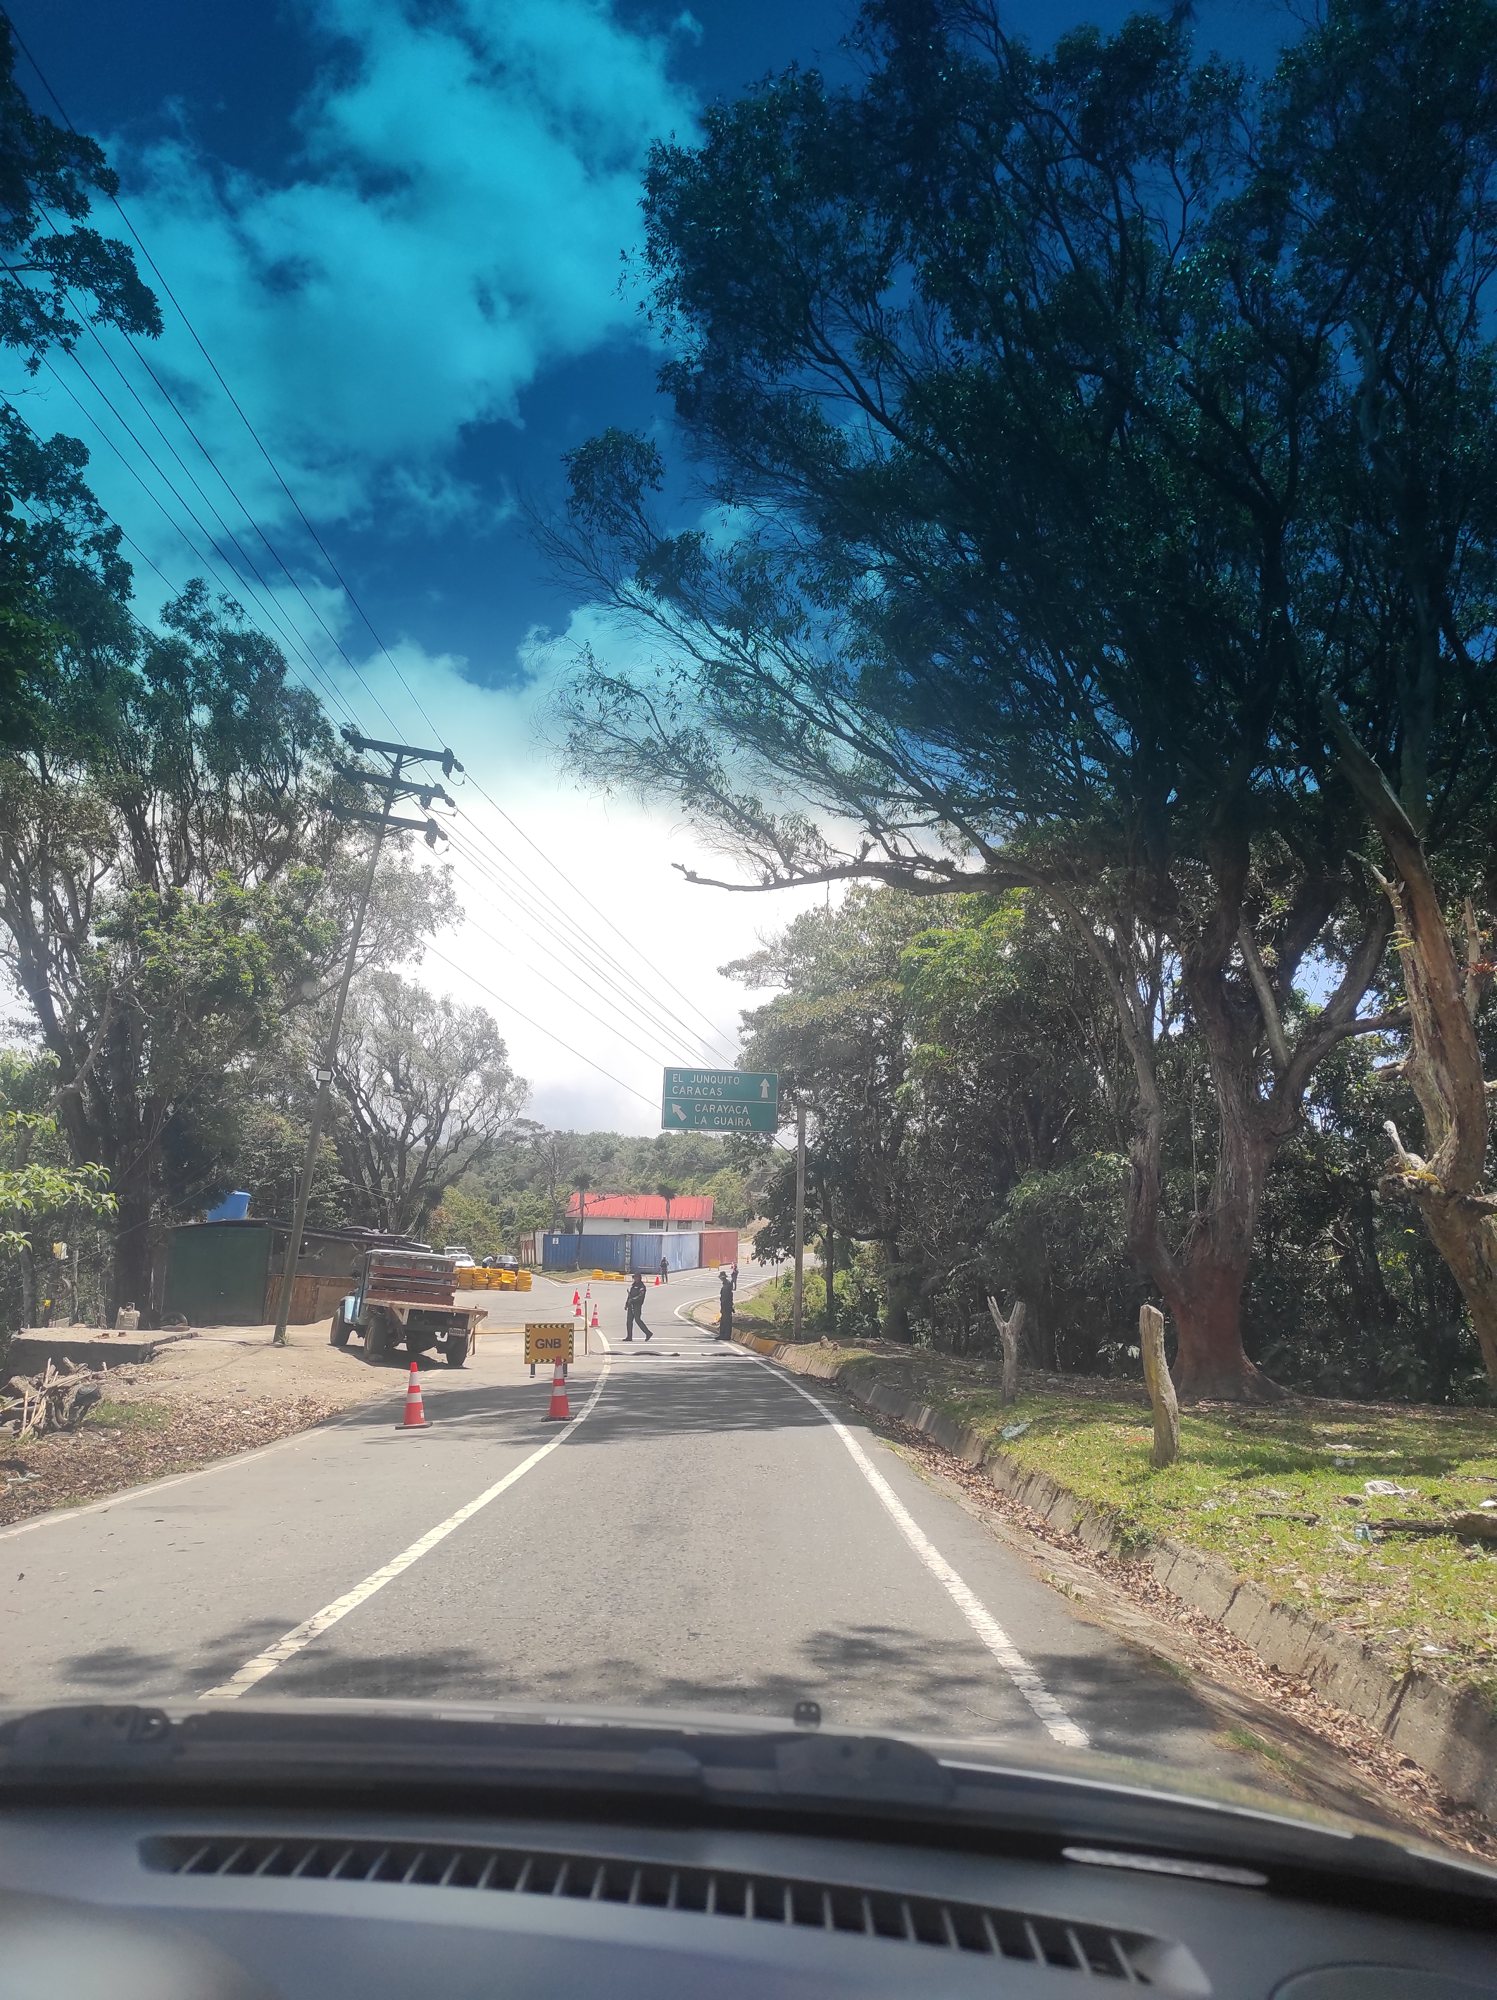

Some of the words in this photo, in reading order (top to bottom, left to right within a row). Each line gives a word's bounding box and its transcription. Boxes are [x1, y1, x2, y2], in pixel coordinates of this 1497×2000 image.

[672, 1073, 683, 1083] EL
[690, 1074, 740, 1085] JUNQUITO
[672, 1085, 723, 1096] CARACAS
[694, 1103, 749, 1115] CARAYACA
[694, 1116, 707, 1125] LA
[713, 1116, 752, 1127] GUAIRA
[535, 1338, 562, 1350] GNB
